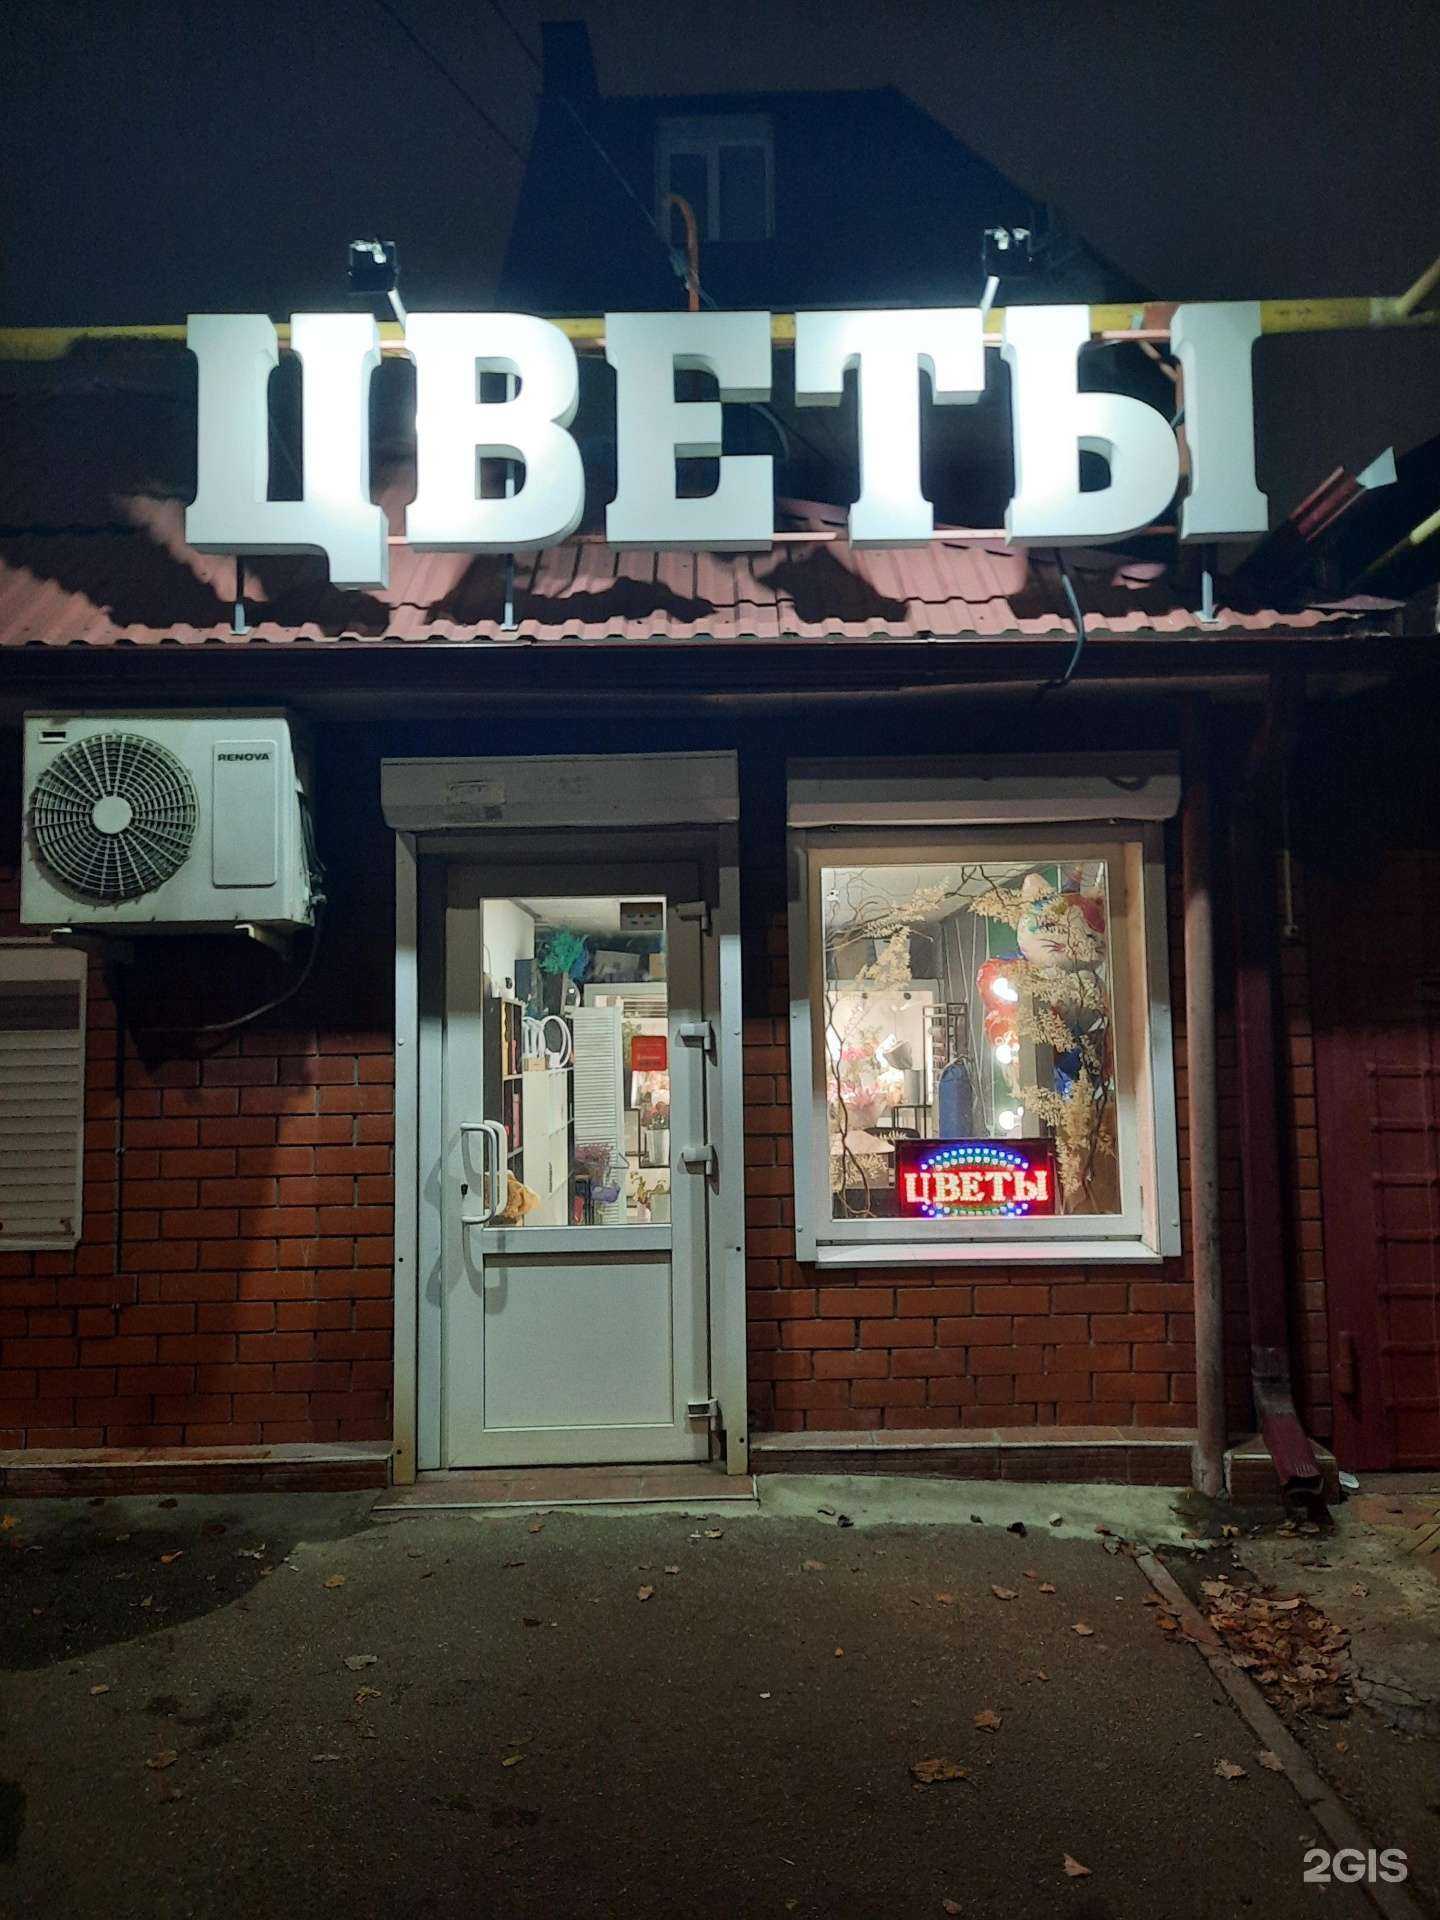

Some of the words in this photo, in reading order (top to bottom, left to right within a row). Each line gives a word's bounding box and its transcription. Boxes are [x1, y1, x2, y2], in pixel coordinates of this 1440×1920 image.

[185, 301, 1269, 590] ЦВЕТЫ
[217, 753, 270, 761] RENOVA
[904, 1170, 1048, 1205] ЦВЕТЫ
